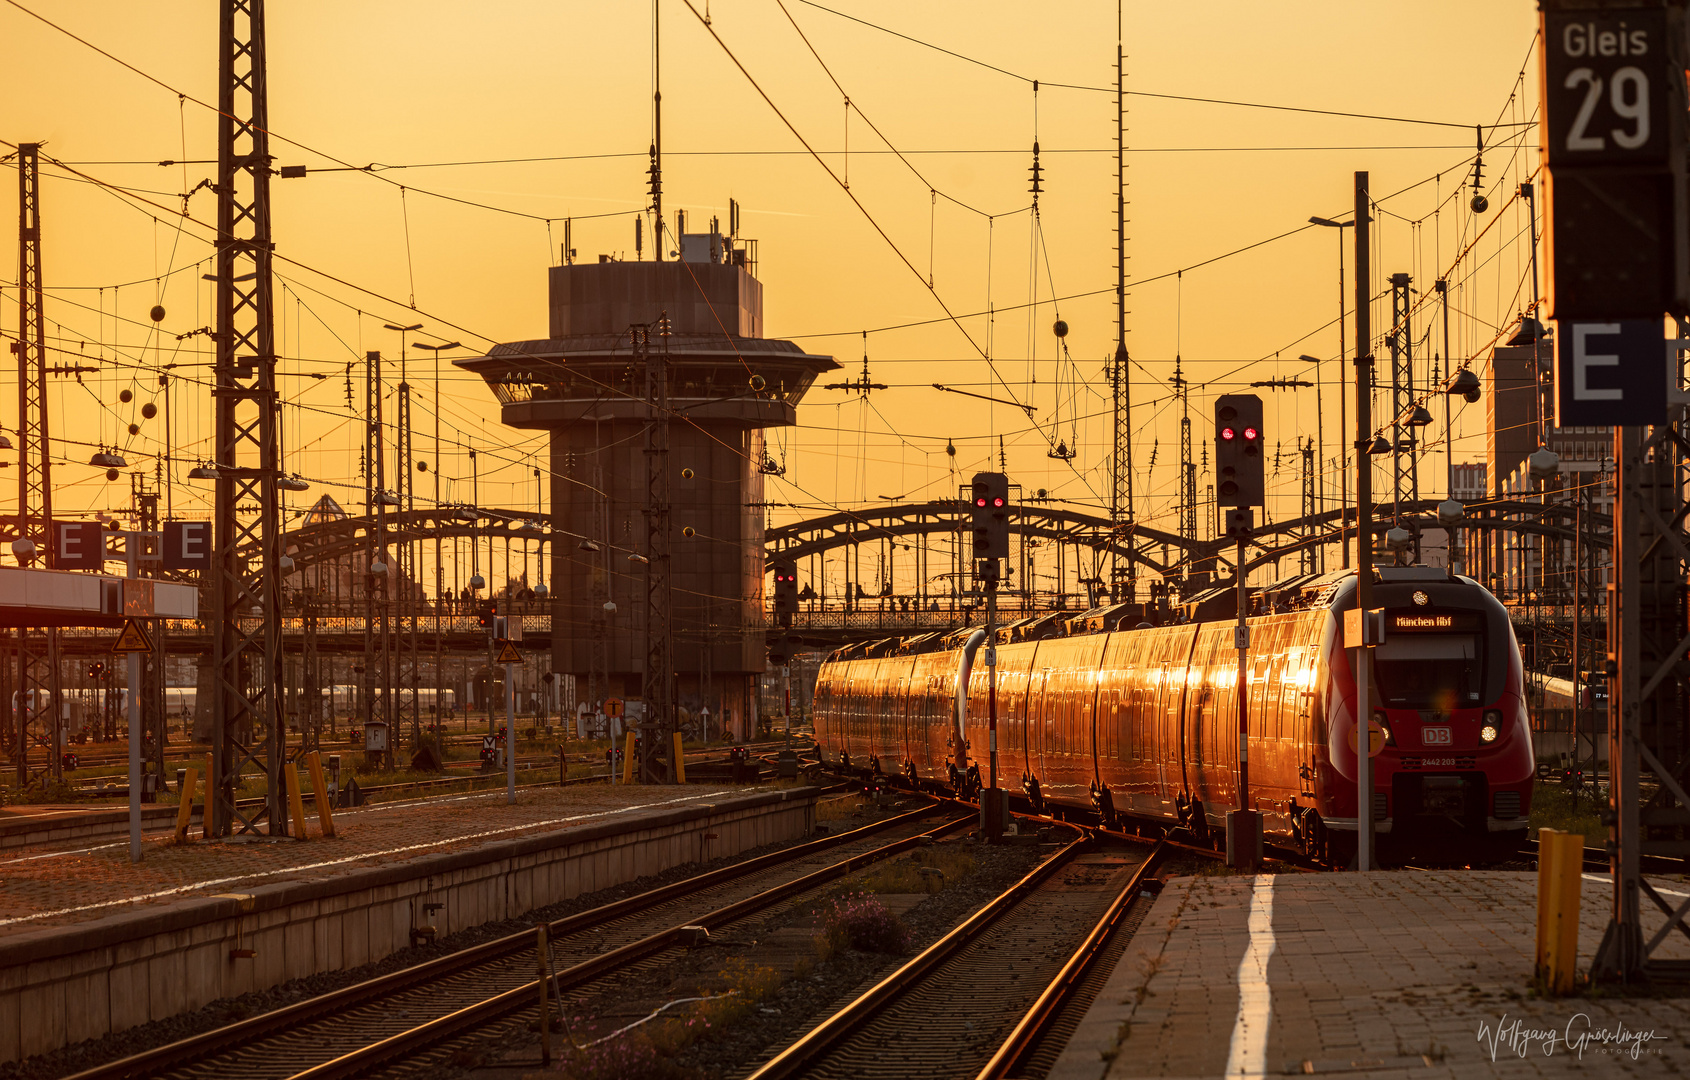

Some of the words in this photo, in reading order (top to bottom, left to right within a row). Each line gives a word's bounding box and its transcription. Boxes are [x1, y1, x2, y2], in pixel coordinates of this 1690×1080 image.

[1563, 22, 1649, 57] Gleis
[1564, 66, 1651, 152] 29
[1572, 323, 1624, 401] E
[1454, 463, 1487, 471] LANCO
[60, 524, 83, 559] E
[181, 524, 204, 559] E
[1396, 617, 1434, 627] München
[1436, 616, 1452, 627] Hbf
[1239, 629, 1245, 638] N
[373, 729, 379, 741] F
[1424, 729, 1450, 743] DB
[1441, 758, 1455, 766] 203
